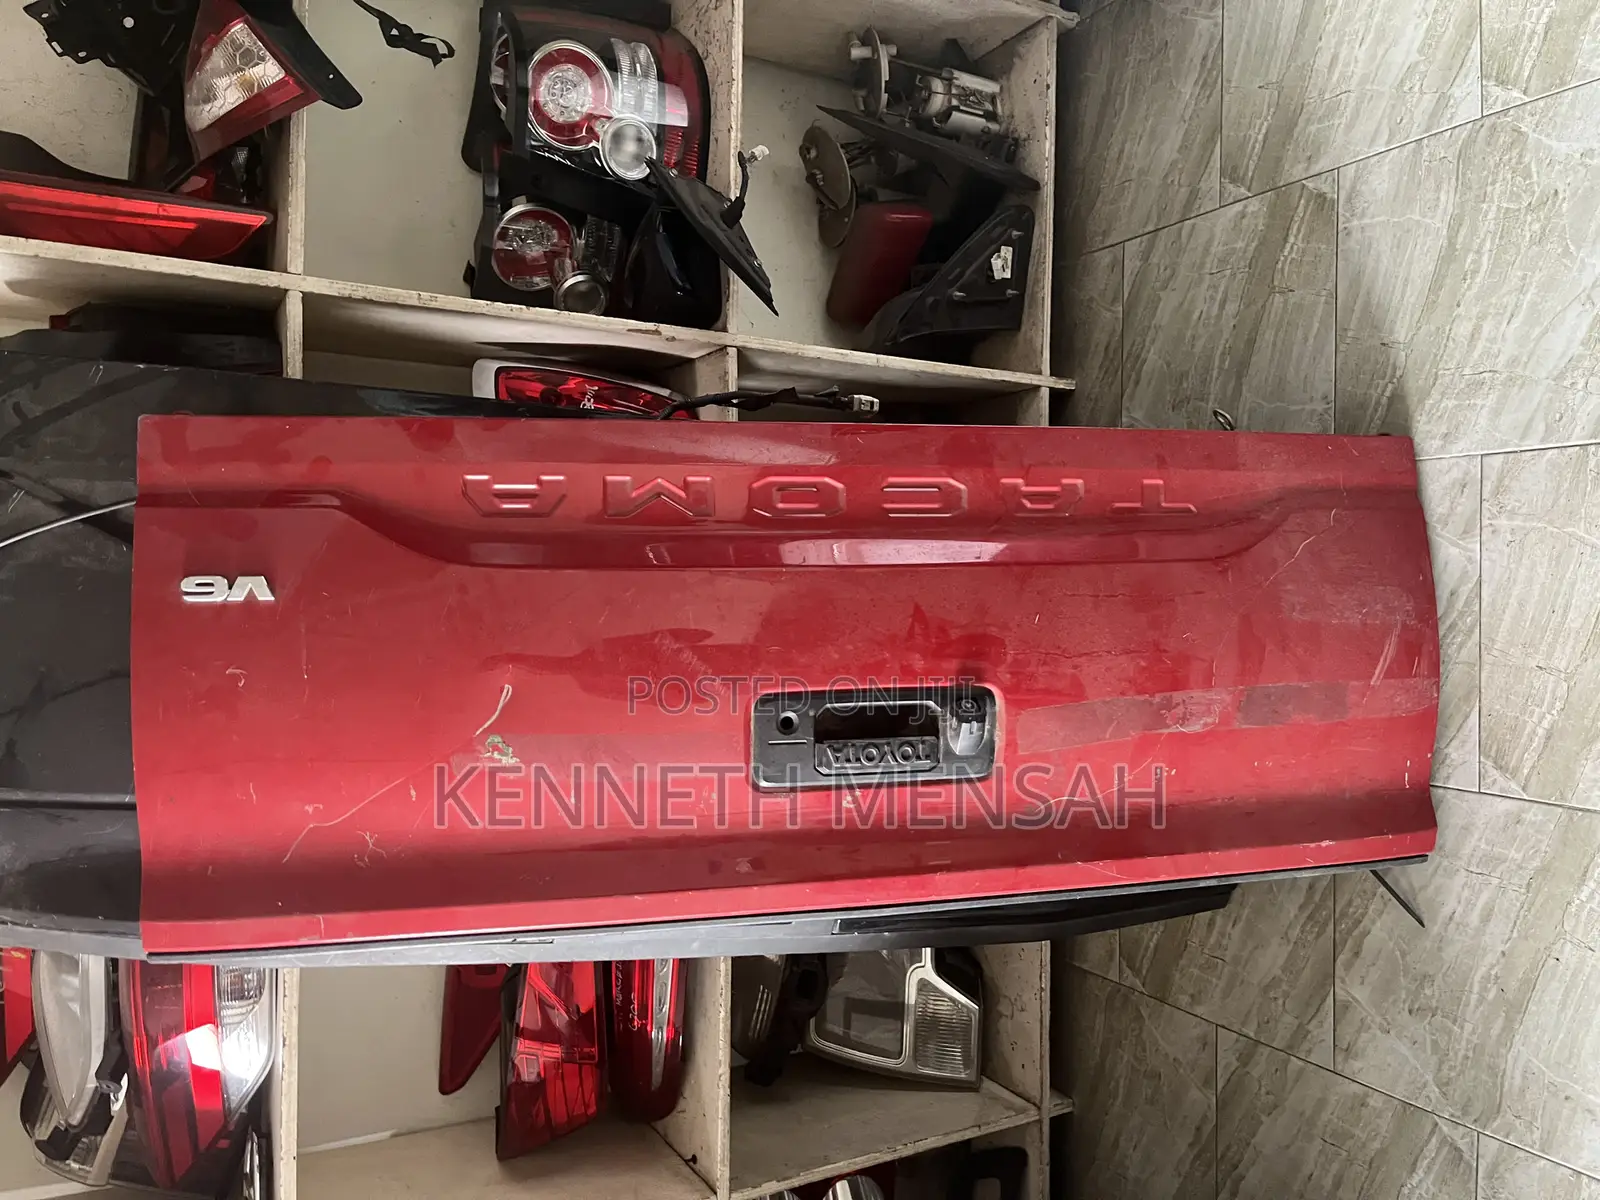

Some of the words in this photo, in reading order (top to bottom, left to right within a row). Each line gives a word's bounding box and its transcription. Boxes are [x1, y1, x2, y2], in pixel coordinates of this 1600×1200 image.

[460, 473, 1198, 518] TACOMA
[180, 575, 275, 602] V6
[825, 742, 932, 767] TOYOTA
